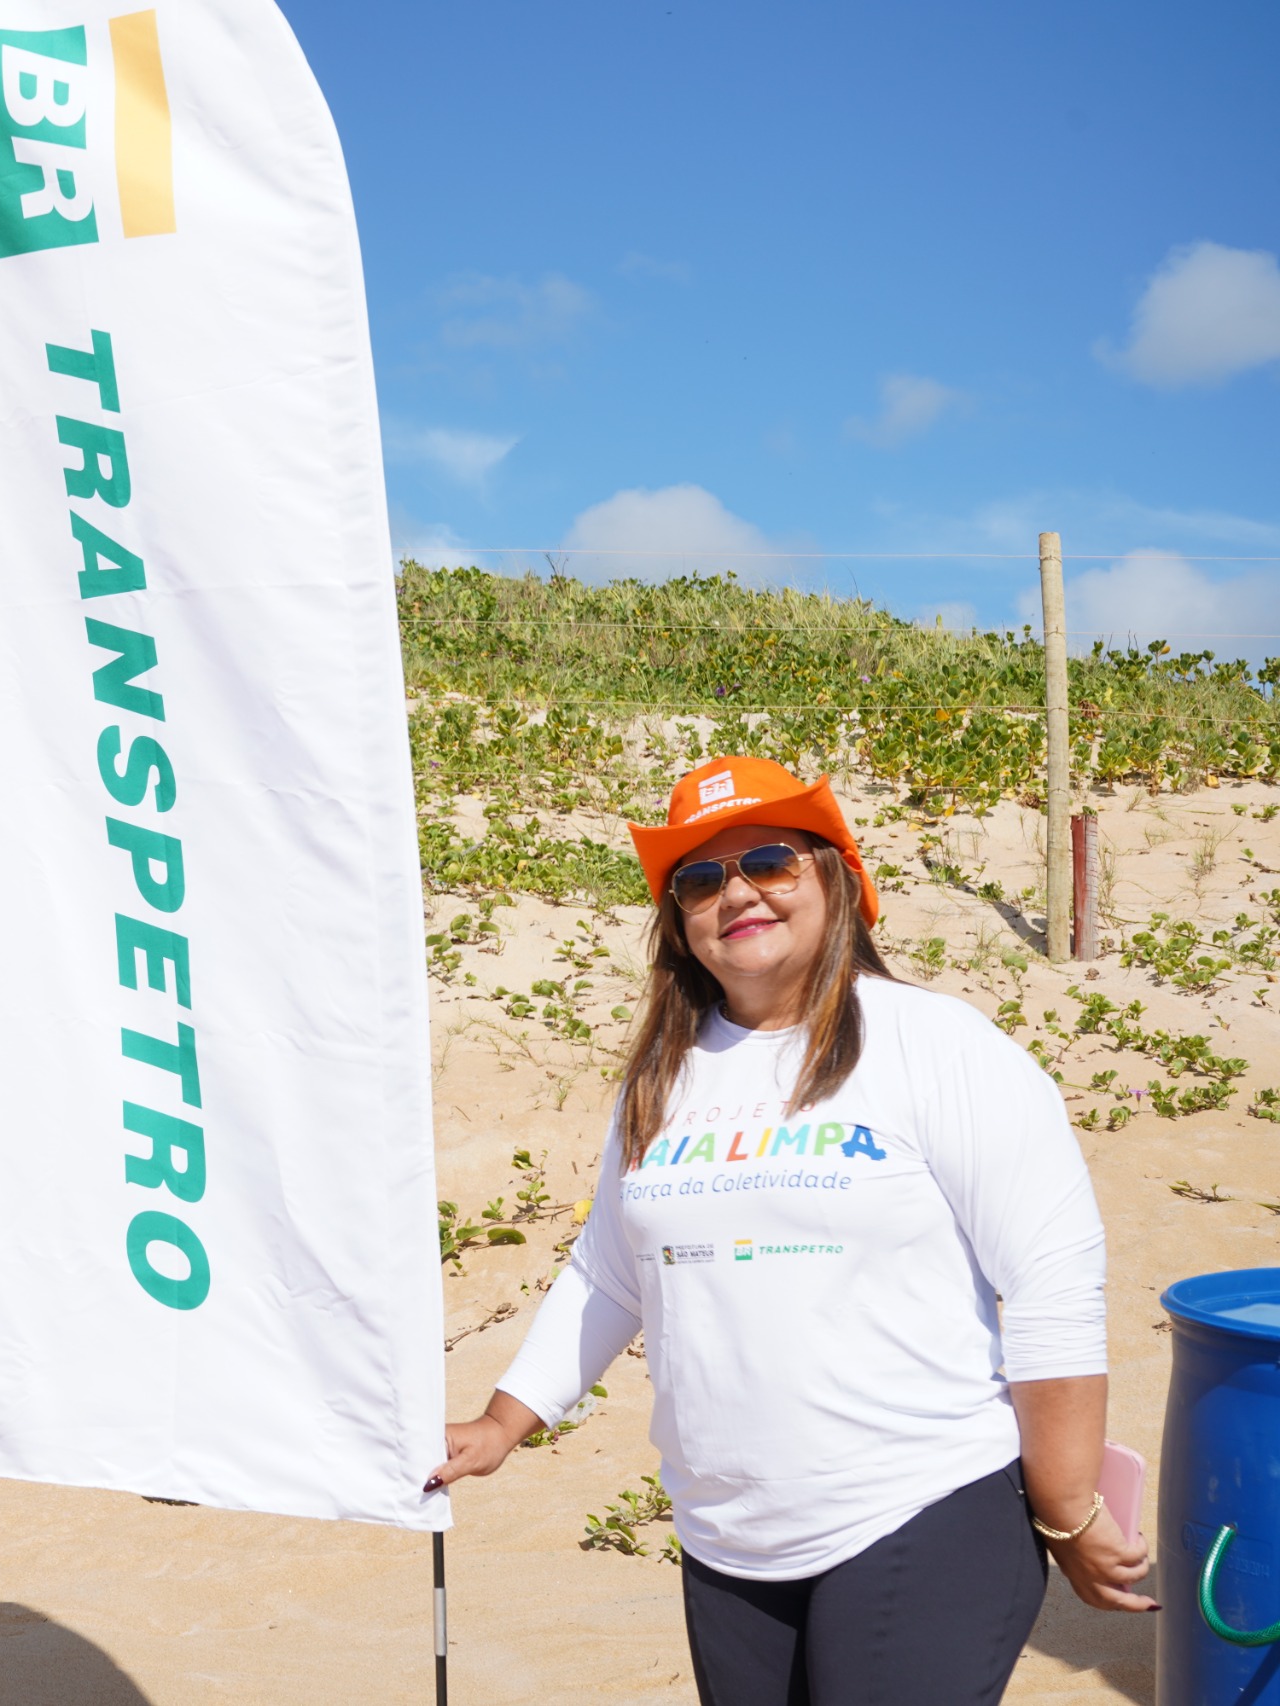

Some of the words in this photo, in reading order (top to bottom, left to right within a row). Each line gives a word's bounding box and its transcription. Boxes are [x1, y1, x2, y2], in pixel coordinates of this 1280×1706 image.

[0, 43, 94, 222] BR
[45, 329, 211, 1311] TRANSPETRO
[670, 1100, 816, 1127] ROJETO
[726, 1122, 887, 1162] LIMPA
[626, 1182, 671, 1201] Força
[679, 1177, 704, 1195] da
[712, 1170, 852, 1193] Coletividade
[759, 1245, 844, 1254] TRANSPETRO
